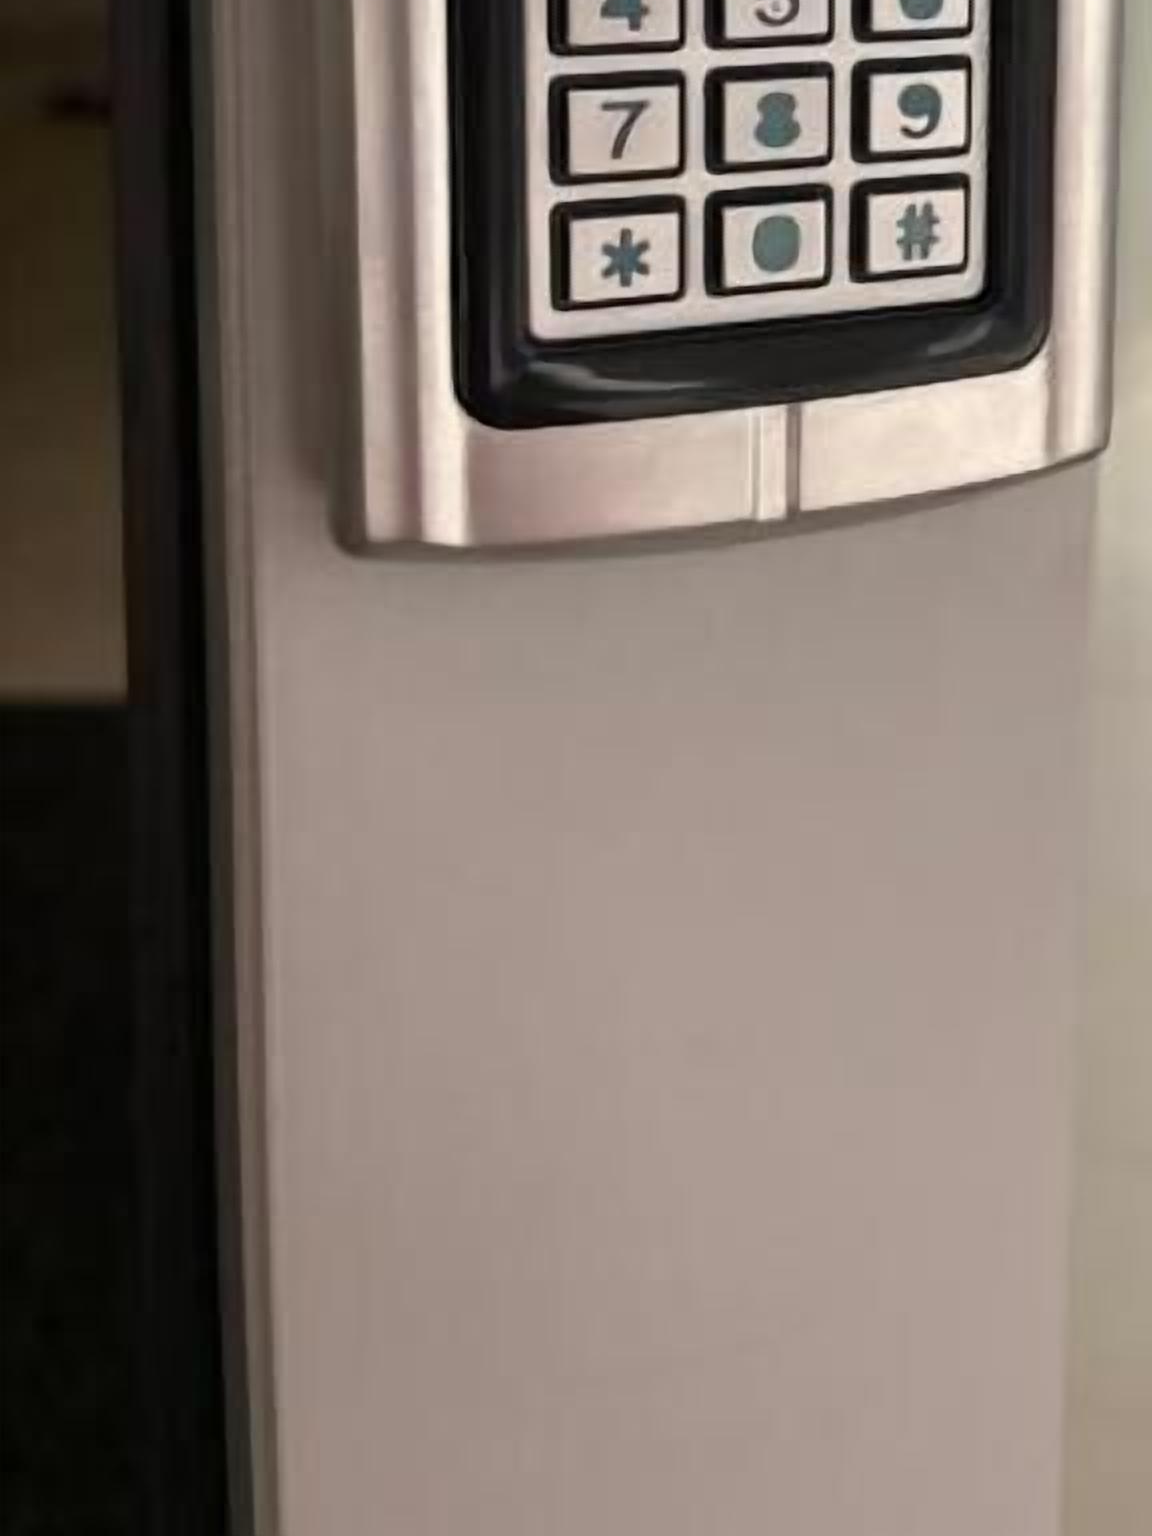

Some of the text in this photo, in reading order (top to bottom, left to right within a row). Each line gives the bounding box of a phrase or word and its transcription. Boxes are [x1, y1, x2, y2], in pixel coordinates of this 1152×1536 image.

[600, 83, 942, 159] 7 8 9
[752, 215, 801, 273] 0
